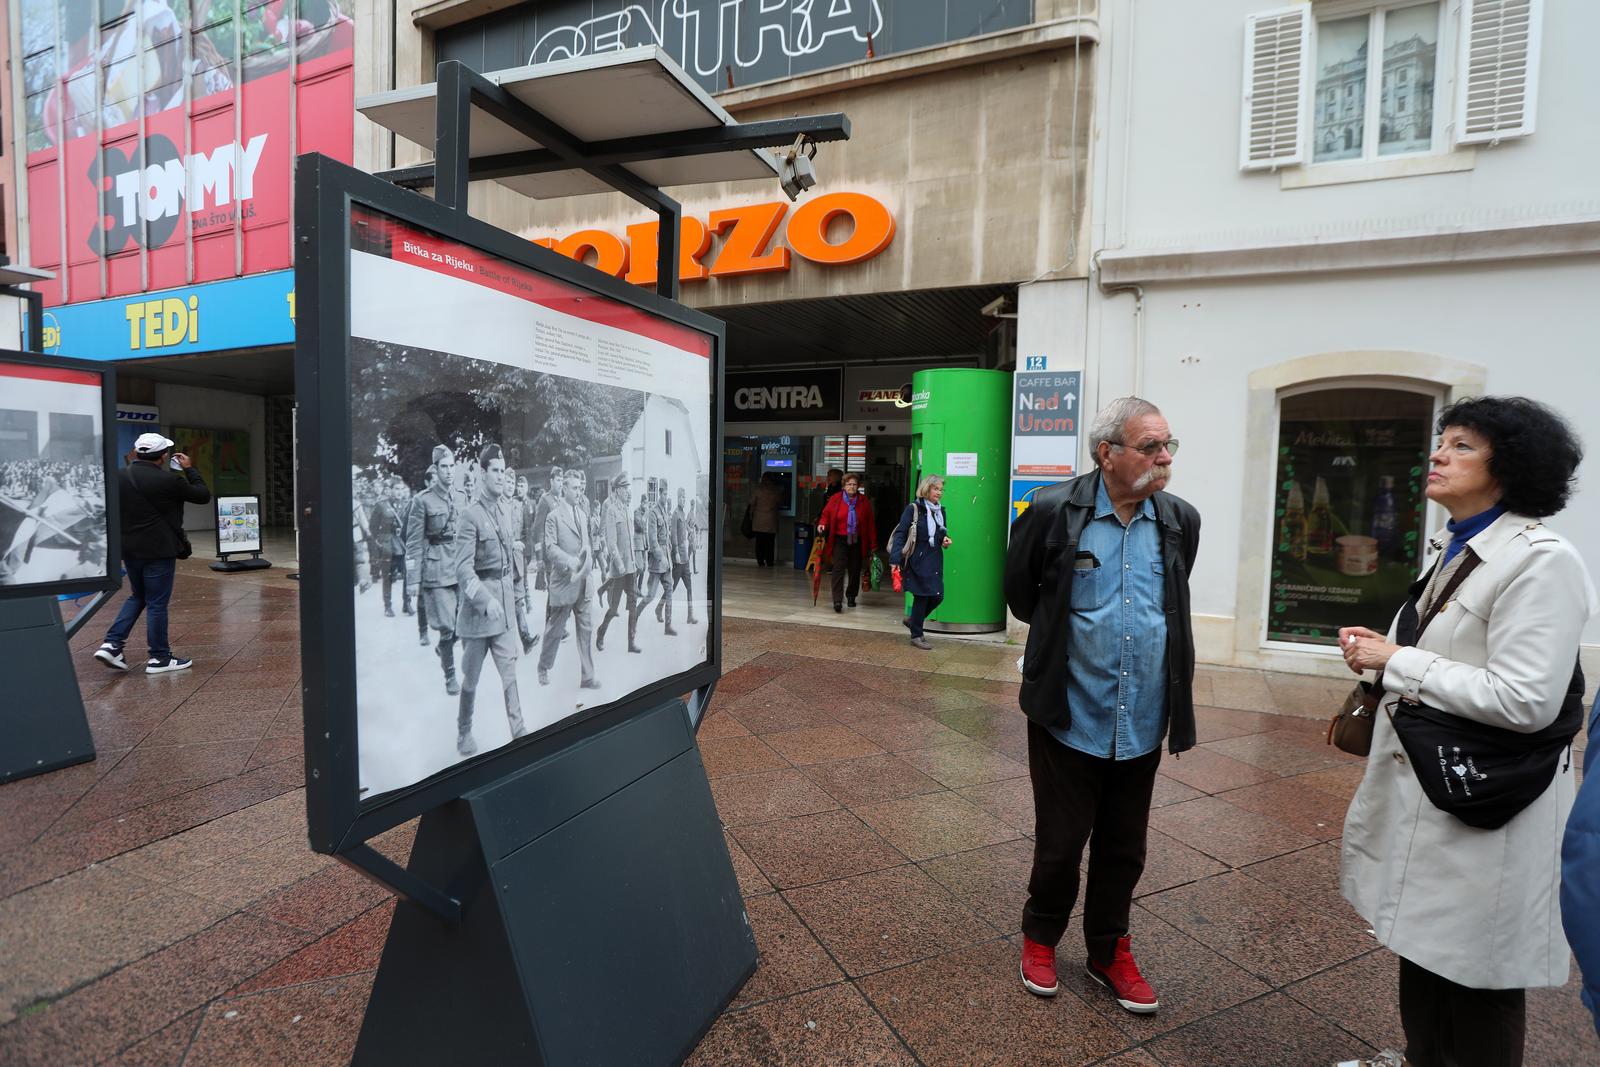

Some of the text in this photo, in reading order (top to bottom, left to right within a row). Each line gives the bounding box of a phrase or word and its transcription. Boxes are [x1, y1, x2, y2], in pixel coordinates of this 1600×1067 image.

[116, 133, 268, 227] TOMMY
[210, 212, 226, 226] ŠTO
[533, 192, 896, 285] ORZO
[403, 241, 430, 259] Bitka
[431, 252, 443, 263] za
[445, 254, 474, 272] Rijeku
[126, 295, 199, 350] TEDi
[43, 326, 61, 348] EDi
[1030, 357, 1042, 367] 12
[1019, 377, 1076, 388] CAFFE BAR
[734, 385, 824, 410] CENTRA
[1019, 391, 1059, 411] Nad
[1019, 414, 1073, 432] Urom
